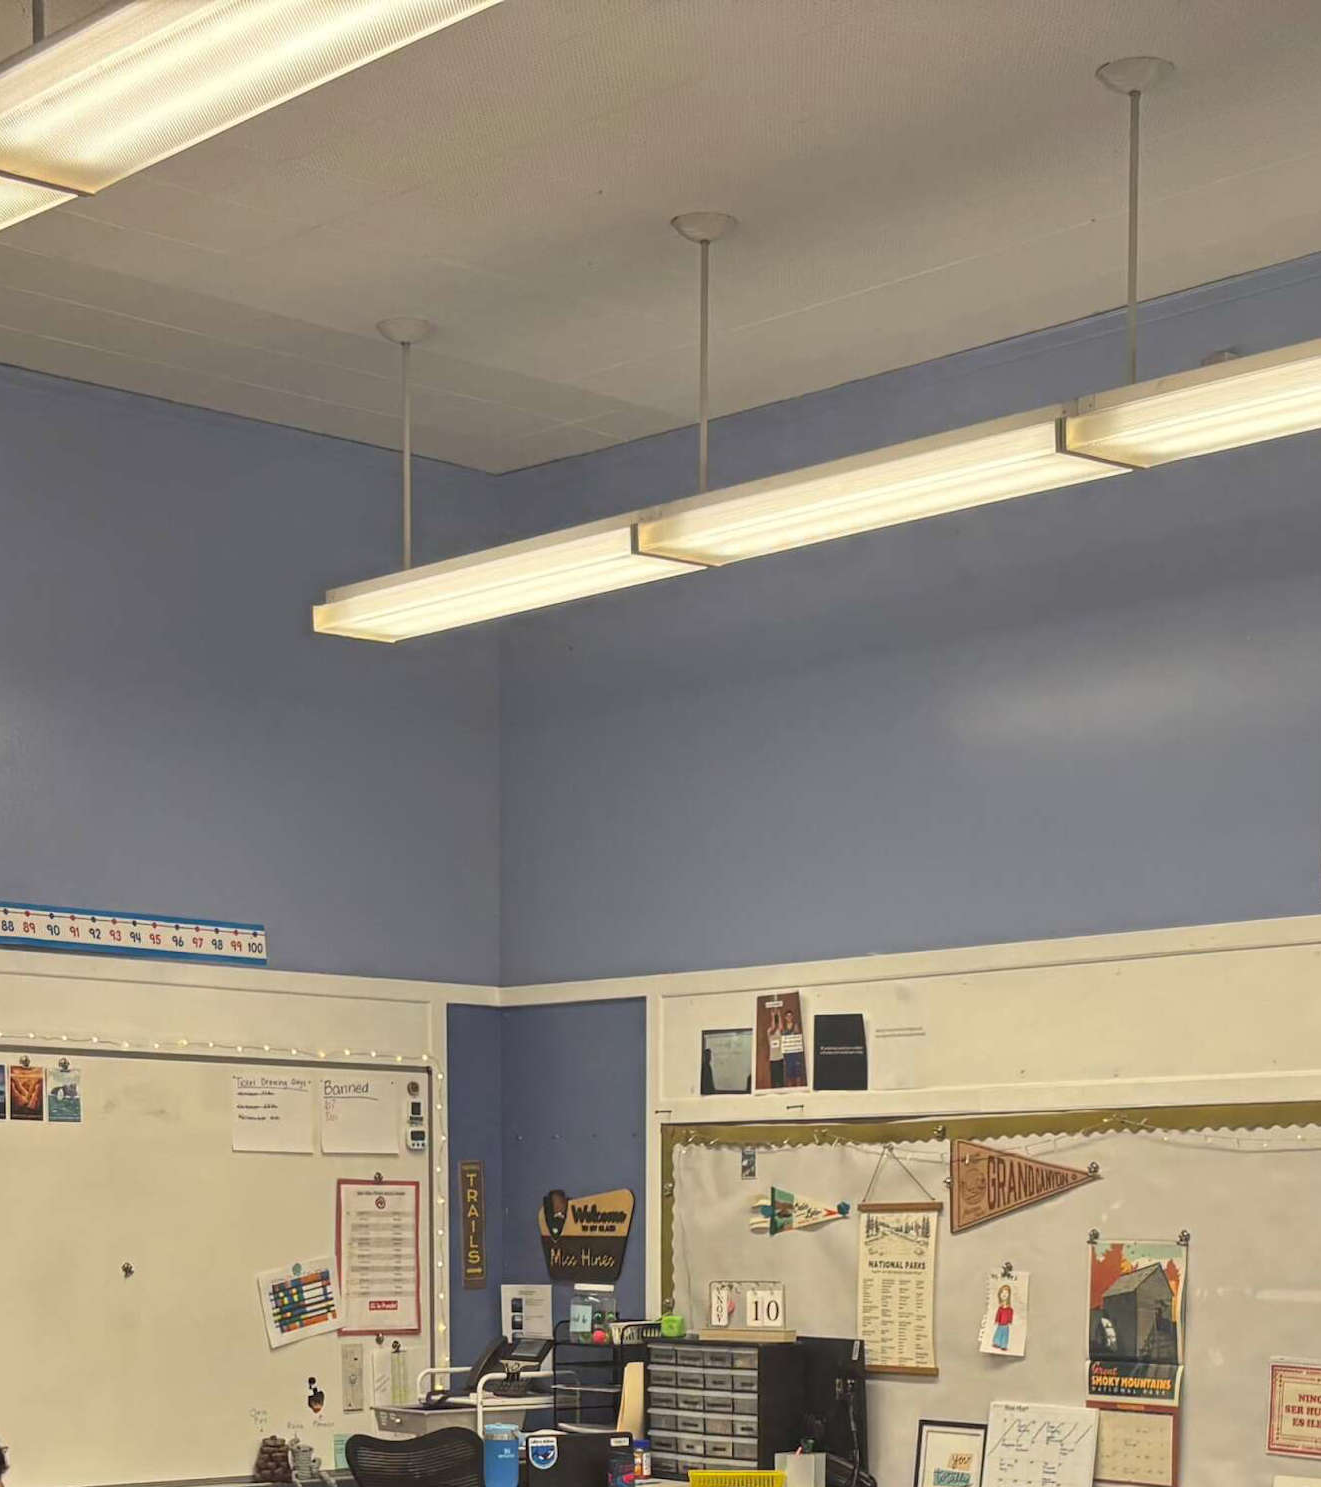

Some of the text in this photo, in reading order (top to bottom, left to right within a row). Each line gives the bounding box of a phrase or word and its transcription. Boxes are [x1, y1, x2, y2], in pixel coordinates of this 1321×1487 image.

[1, 919, 15, 933] 88
[22, 920, 36, 934] 89
[46, 922, 61, 937] 90
[69, 924, 80, 938] 91
[88, 926, 102, 940] 92
[109, 928, 122, 942] 93
[130, 930, 142, 944] 94
[149, 932, 162, 946] 95
[171, 934, 185, 948] 96
[192, 936, 204, 950] 97
[211, 938, 224, 951] 98
[230, 939, 243, 953] 99
[247, 941, 263, 955] 100
[323, 1080, 369, 1096] Banned
[987, 1156, 1035, 1209] GRAND
[466, 1173, 480, 1264] TRAILS
[868, 1261, 926, 1270] NATIONAL PARKS
[752, 1300, 779, 1321] 10
[1092, 1376, 1172, 1390] SMOKY MOUNTAINS
[1285, 1405, 1304, 1414] SER
[1292, 1418, 1304, 1427] ES
